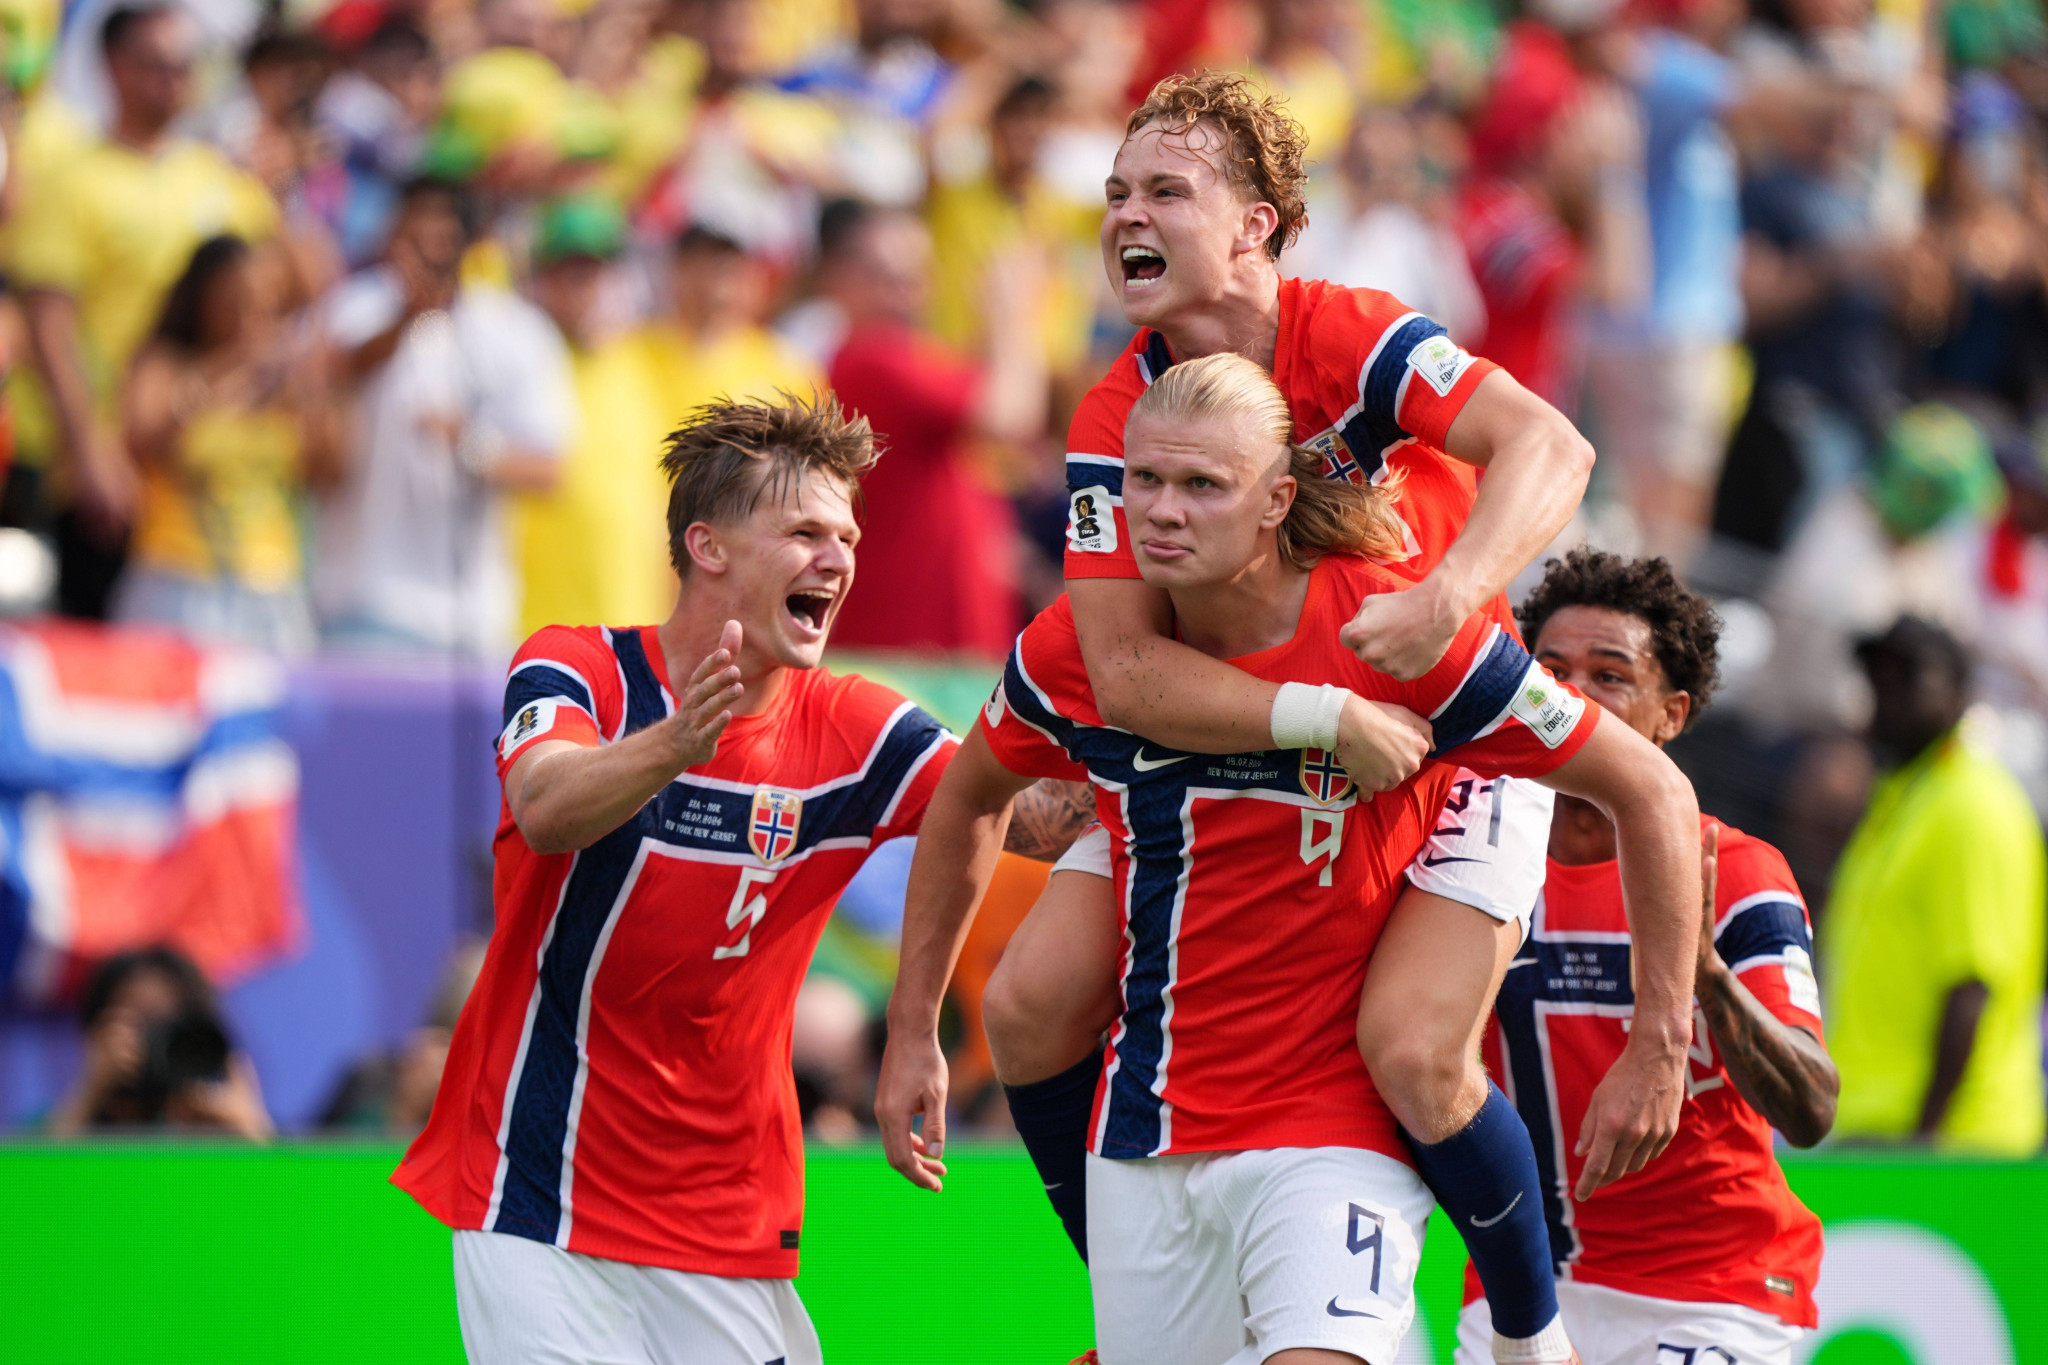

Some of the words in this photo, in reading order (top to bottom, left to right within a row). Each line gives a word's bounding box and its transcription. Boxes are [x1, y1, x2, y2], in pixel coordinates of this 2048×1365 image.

[1207, 767, 1221, 777] NEW
[1223, 768, 1240, 779] YORK
[1251, 770, 1279, 781] JERSEY
[664, 819, 676, 831] NEW
[676, 823, 693, 836] YORK
[693, 827, 710, 839] NEW
[710, 830, 738, 843] JERSEY
[707, 802, 722, 813] NOR
[1299, 807, 1345, 887] 9
[712, 865, 779, 960] 5
[1346, 1201, 1386, 1296] 9
